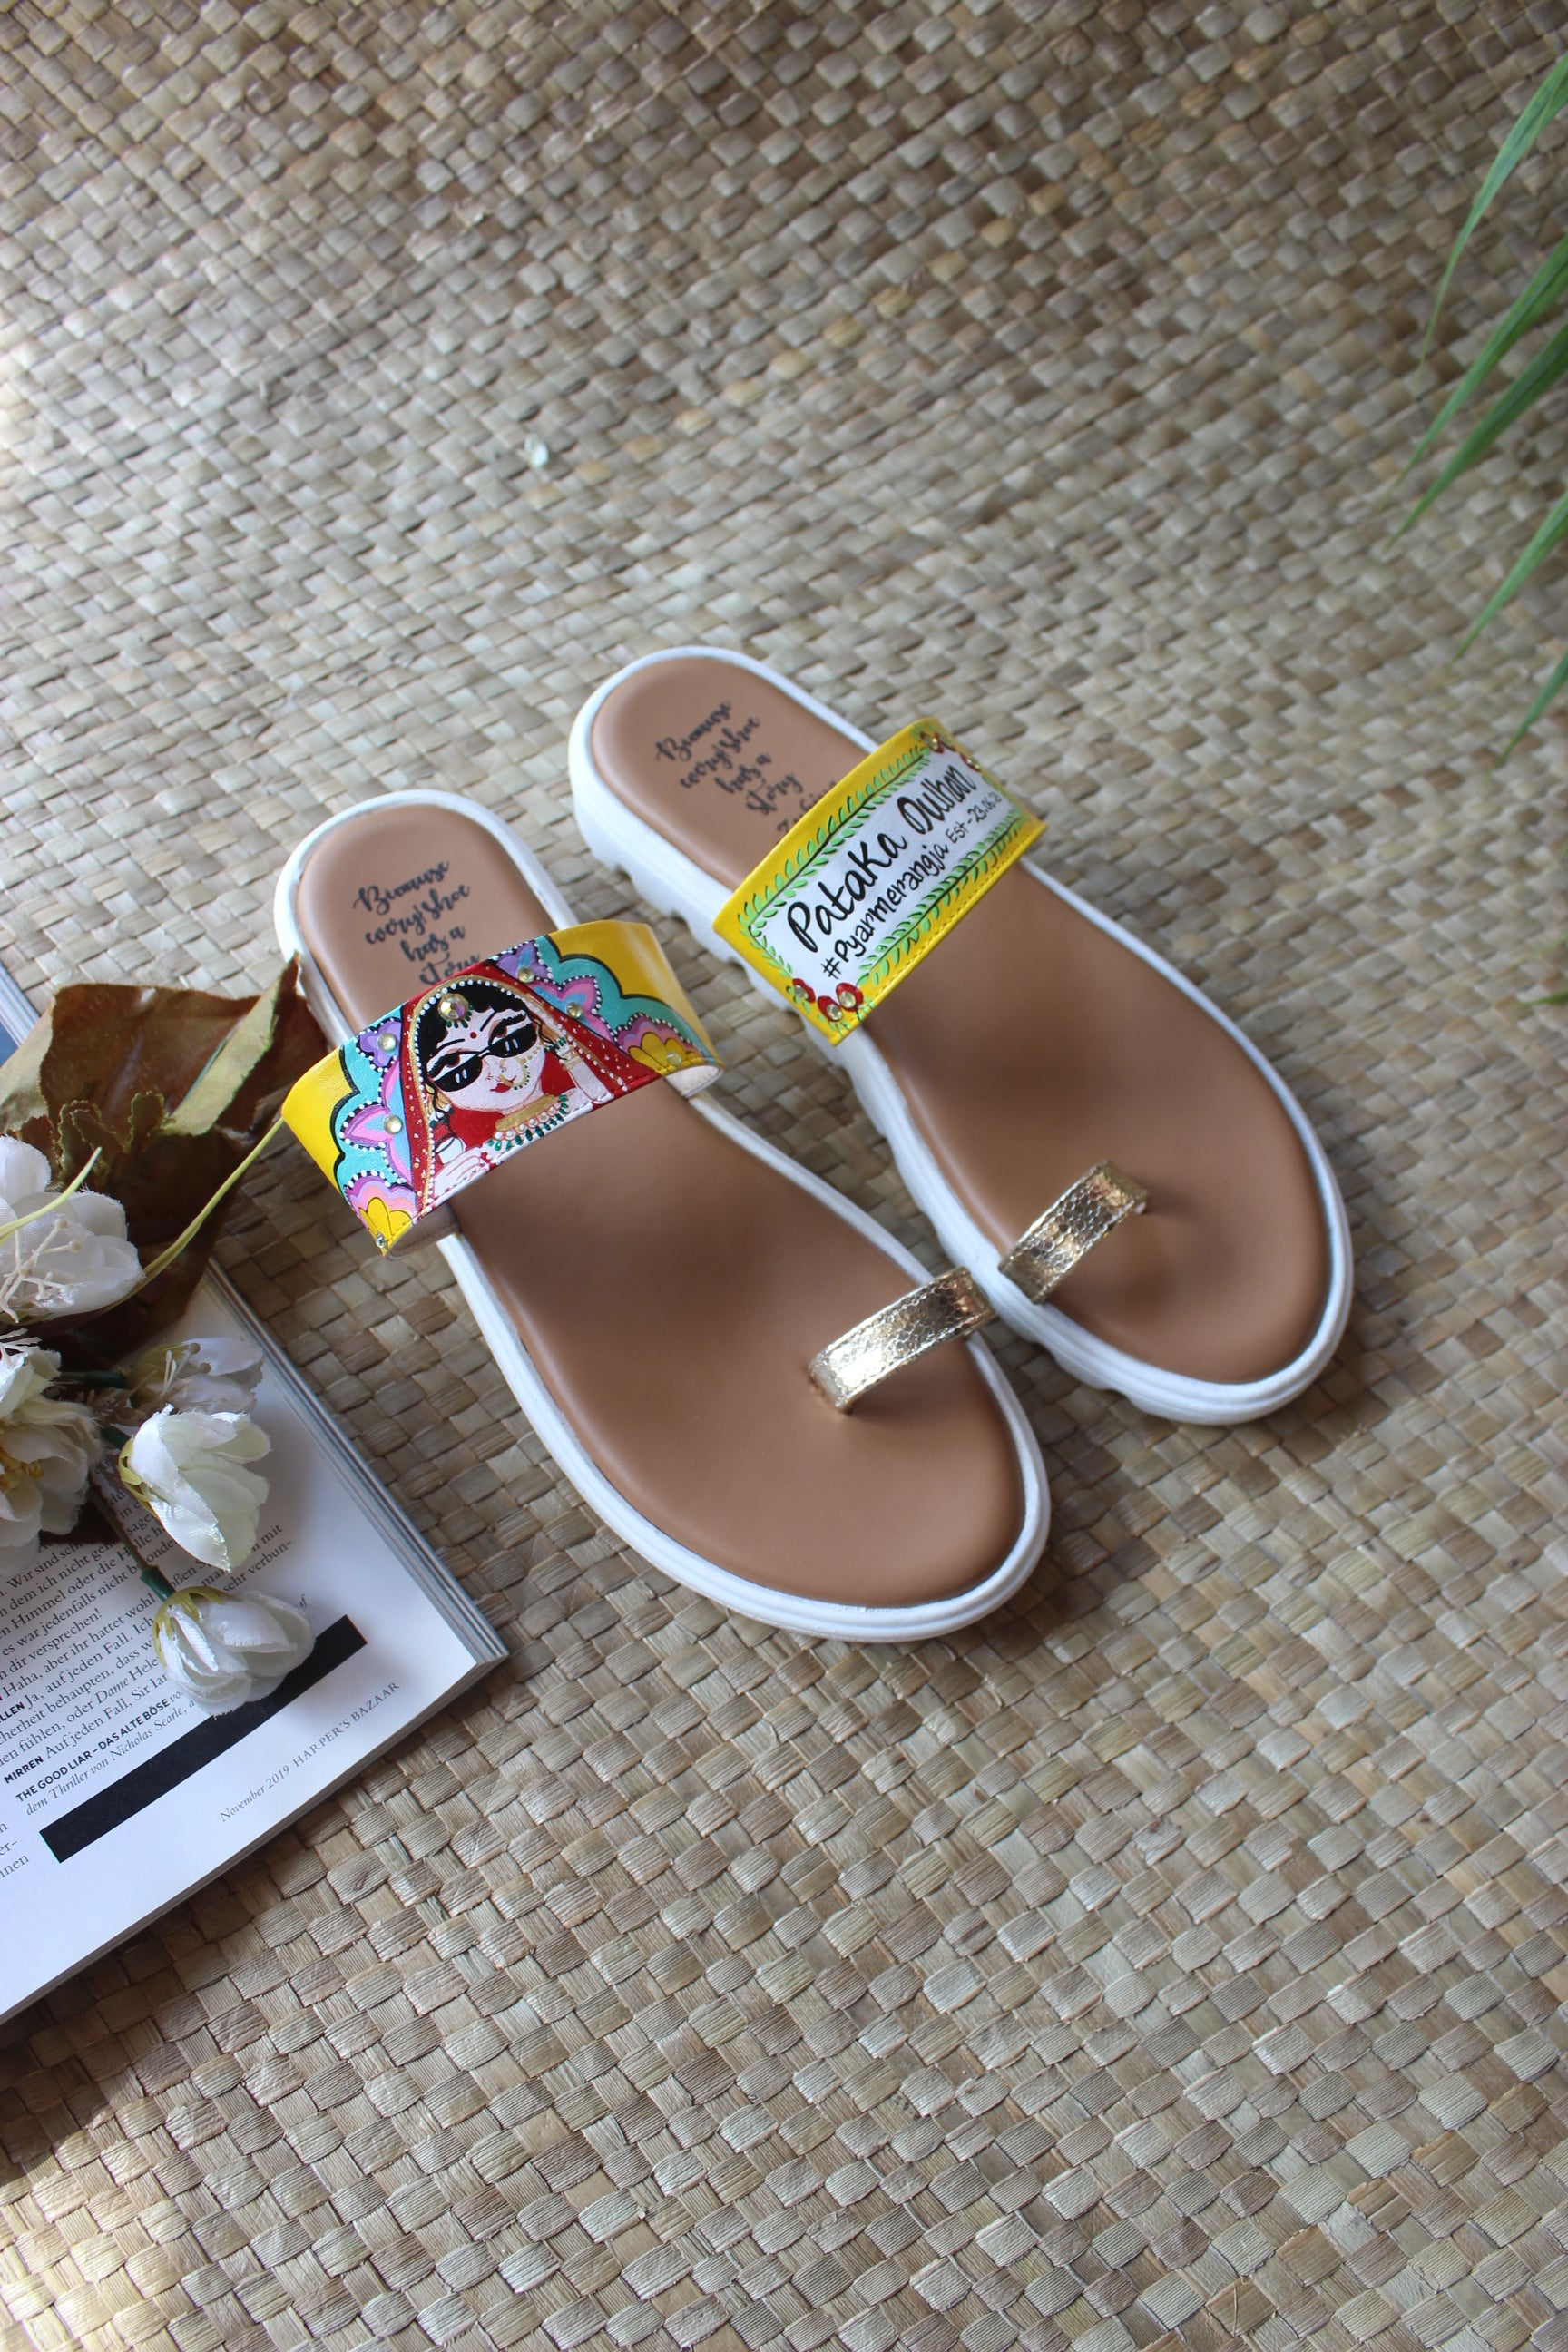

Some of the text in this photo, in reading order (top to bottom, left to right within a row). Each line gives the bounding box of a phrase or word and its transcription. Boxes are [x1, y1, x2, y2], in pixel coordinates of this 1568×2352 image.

[715, 753, 772, 794] has a
[400, 926, 466, 962] has a
[119, 1508, 132, 1519] in
[126, 1514, 154, 1534] sage
[3, 1644, 15, 1656] es
[15, 1628, 39, 1647] war
[40, 1593, 97, 1636] jedenfalls
[97, 1572, 128, 1595] nicht
[6, 1571, 33, 1588] Wir
[34, 1553, 60, 1574] sind
[10, 1590, 37, 1610] dem
[36, 1576, 57, 1592] ich
[58, 1555, 90, 1580] nicht
[11, 1589, 66, 1629] Himmel
[67, 1572, 95, 1594] oder
[97, 1559, 116, 1575] die
[116, 1534, 152, 1561] Hlle
[0, 1702, 25, 1723] LLEN
[24, 1693, 44, 1710] Ja,
[45, 1671, 66, 1693] auf
[65, 1653, 103, 1683] jeden
[103, 1632, 133, 1654] Fall.
[132, 1617, 154, 1634] Ich
[260, 1524, 283, 1544] mit
[3, 1672, 43, 1697] Haha,
[44, 1651, 70, 1673] aber
[69, 1640, 89, 1655] ihr
[88, 1616, 124, 1642] hattet
[124, 1592, 156, 1618] wohl
[9, 1657, 27, 1673] dir
[28, 1608, 102, 1660] versprechen!
[44, 1670, 114, 1713] behaupten,
[115, 1650, 140, 1669] dass
[223, 1573, 247, 1592] sehr
[248, 1541, 291, 1574] verbun-
[4, 1756, 44, 1784] MIRREN
[46, 1734, 70, 1759] Auf
[69, 1718, 104, 1747] jeden
[103, 1698, 133, 1720] Fall,
[131, 1685, 151, 1700] Sir
[15, 1785, 38, 1802] THE
[37, 1766, 69, 1788] GOOD
[67, 1750, 93, 1770] LIAR
[98, 1732, 120, 1750] DAS
[120, 1716, 144, 1737] ALTE
[142, 1699, 171, 1720] BÖSE
[19, 1723, 66, 1752] fühlen,
[66, 1701, 93, 1722] oder
[94, 1678, 130, 1704] Dame
[129, 1657, 160, 1681] Hele
[219, 1681, 400, 1822] November 2019 HARPER'S BAZAAR
[26, 1707, 187, 1816] dem Thriller von Nicholas Searle,
